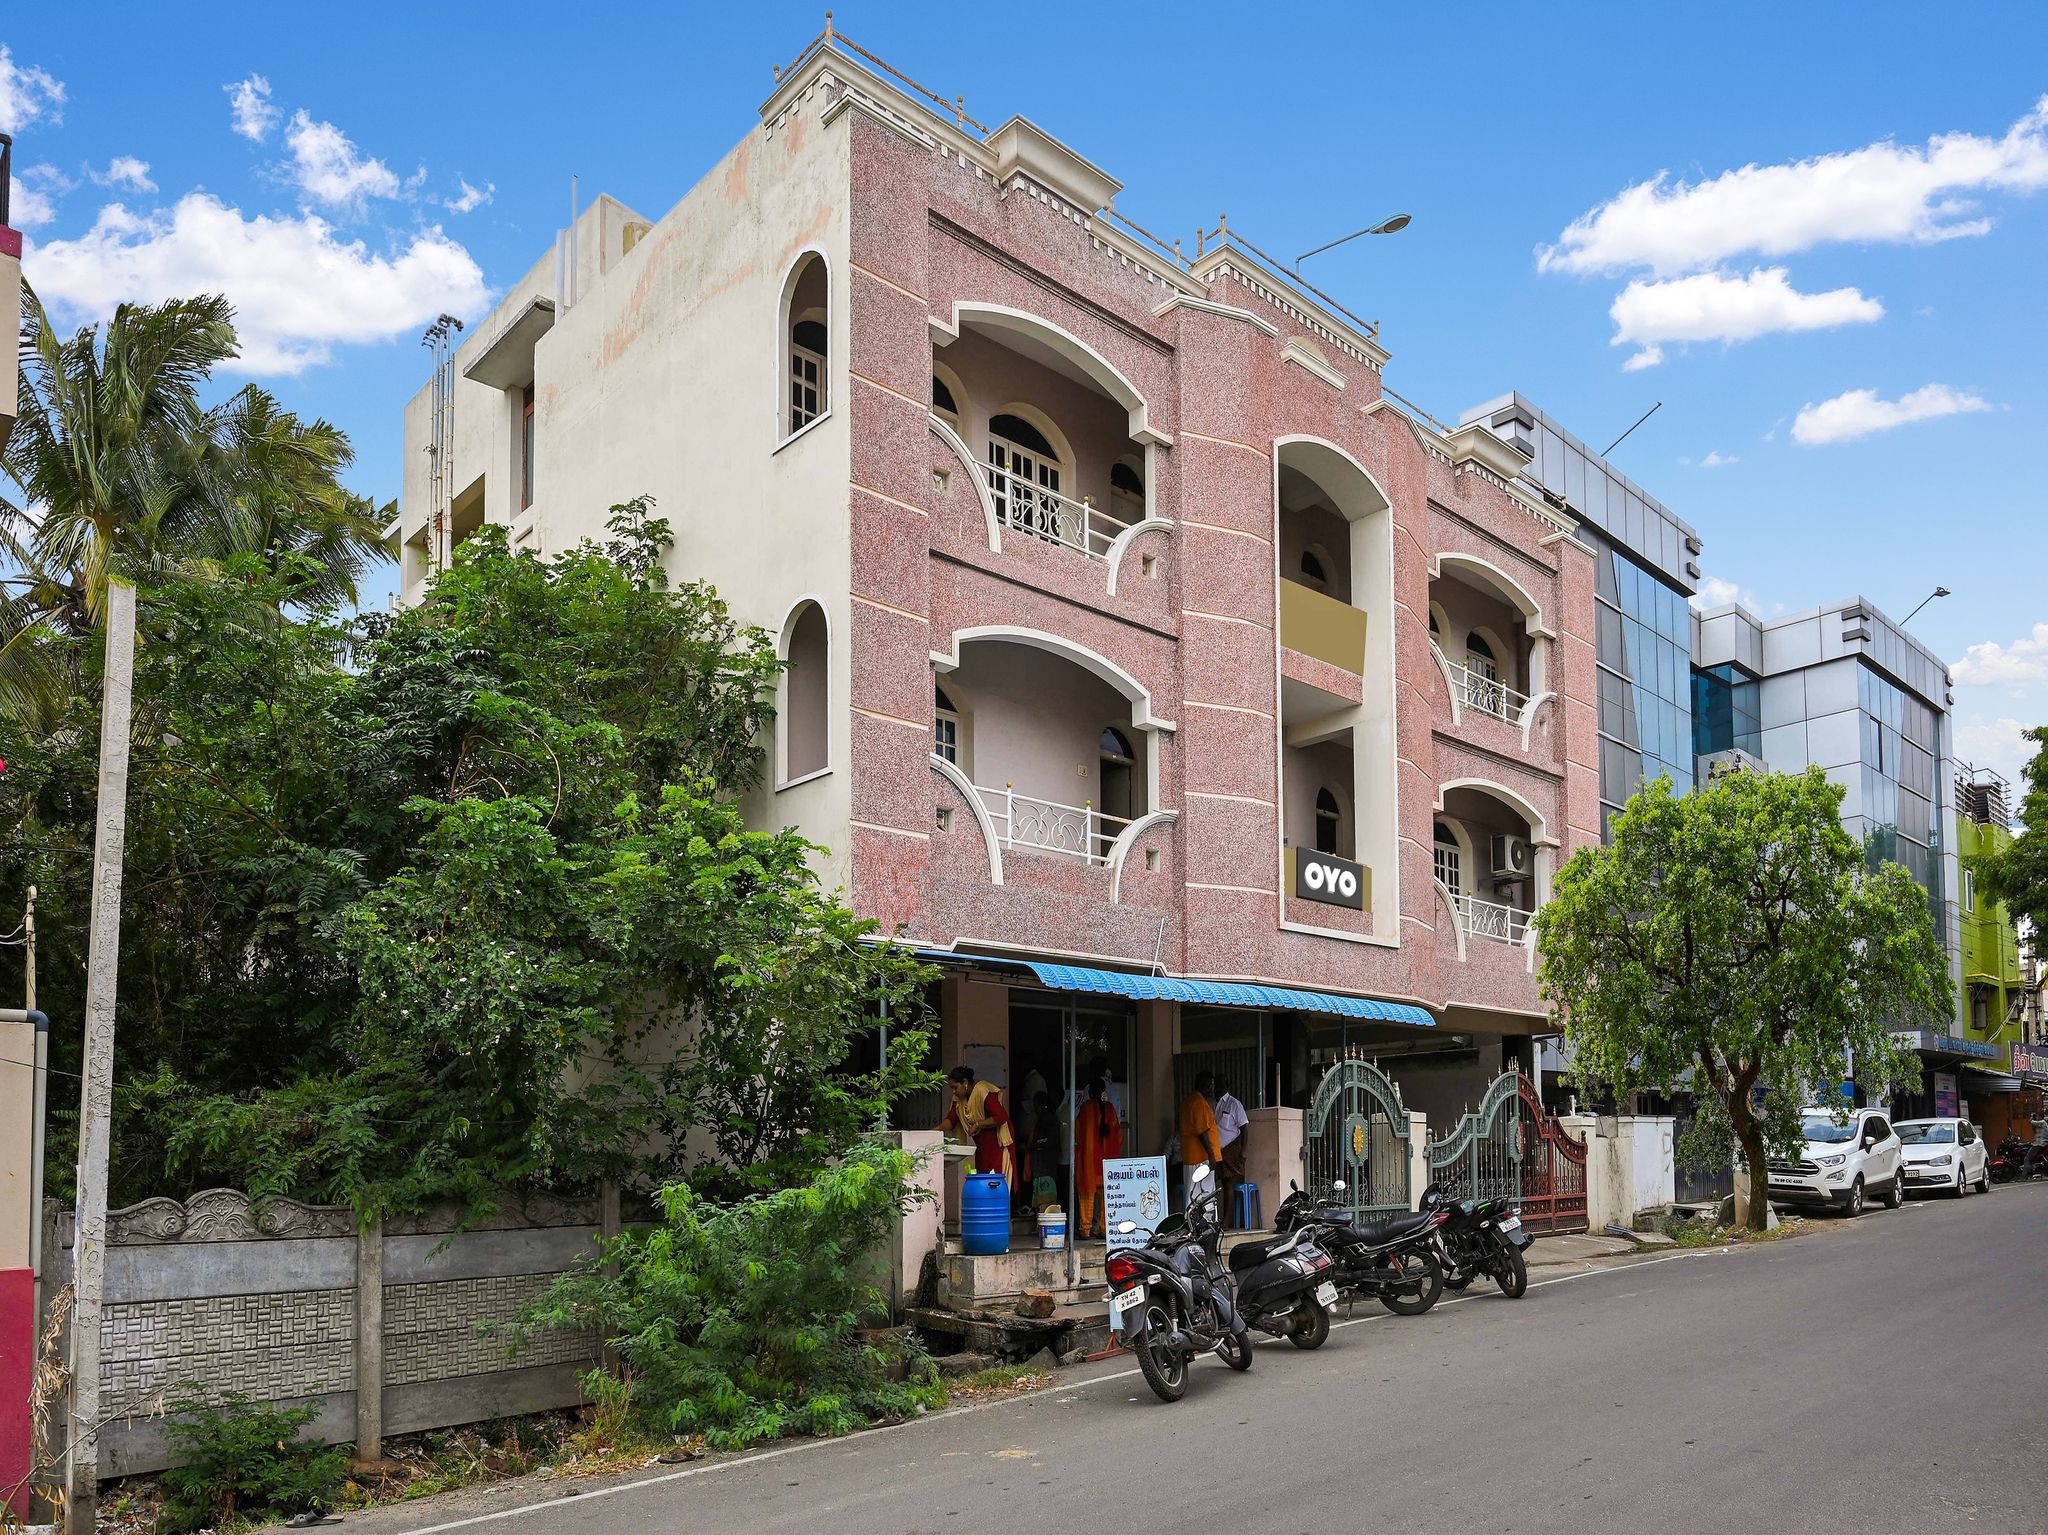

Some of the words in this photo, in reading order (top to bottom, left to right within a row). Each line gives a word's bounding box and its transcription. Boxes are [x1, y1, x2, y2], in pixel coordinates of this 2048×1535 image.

[1305, 861, 1357, 898] OYO
[1107, 1167, 1134, 1181] ஜெயம்
[1136, 1165, 1160, 1179] மெஸ்
